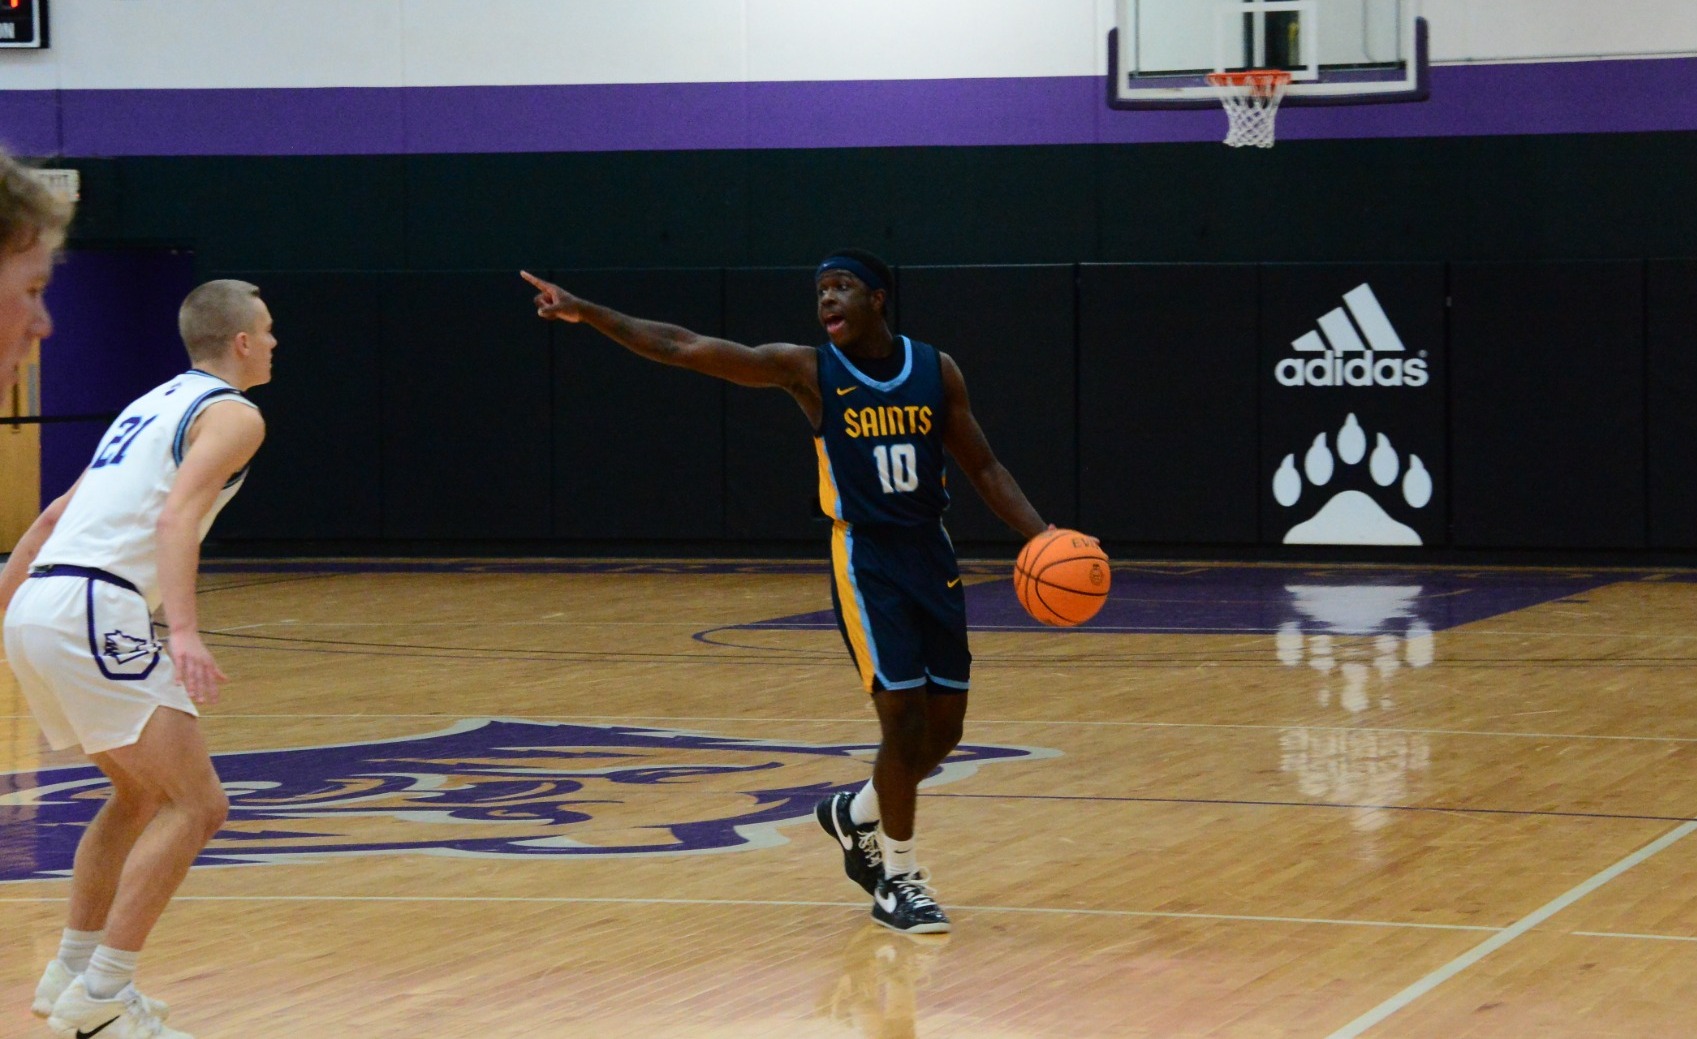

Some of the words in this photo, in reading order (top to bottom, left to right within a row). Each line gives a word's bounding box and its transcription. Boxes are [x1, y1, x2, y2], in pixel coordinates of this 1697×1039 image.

[1274, 350, 1429, 387] adidas
[91, 414, 158, 469] 21
[843, 405, 933, 438] SAINTS
[873, 443, 919, 494] 10
